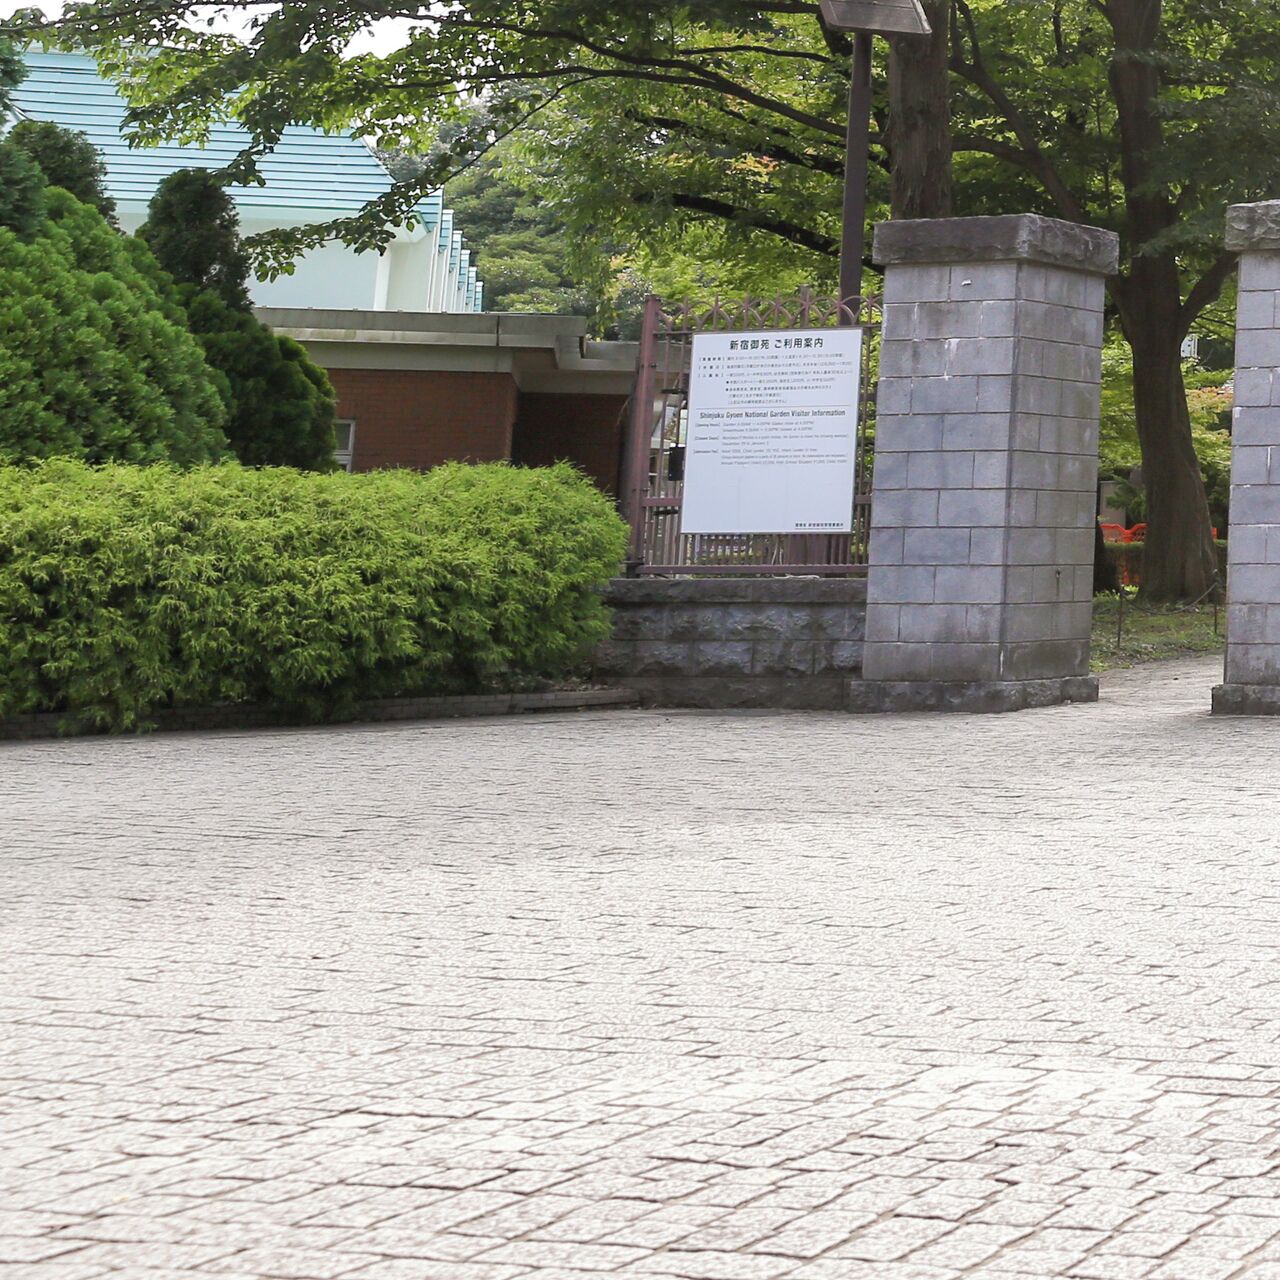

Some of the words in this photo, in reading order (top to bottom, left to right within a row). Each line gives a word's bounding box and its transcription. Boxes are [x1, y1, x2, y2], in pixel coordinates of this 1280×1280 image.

[729, 339, 770, 351] 新宿御苑
[774, 337, 824, 350] ご利用案内
[769, 410, 790, 418] Garden
[791, 409, 811, 417] Visitor
[812, 409, 846, 417] Information
